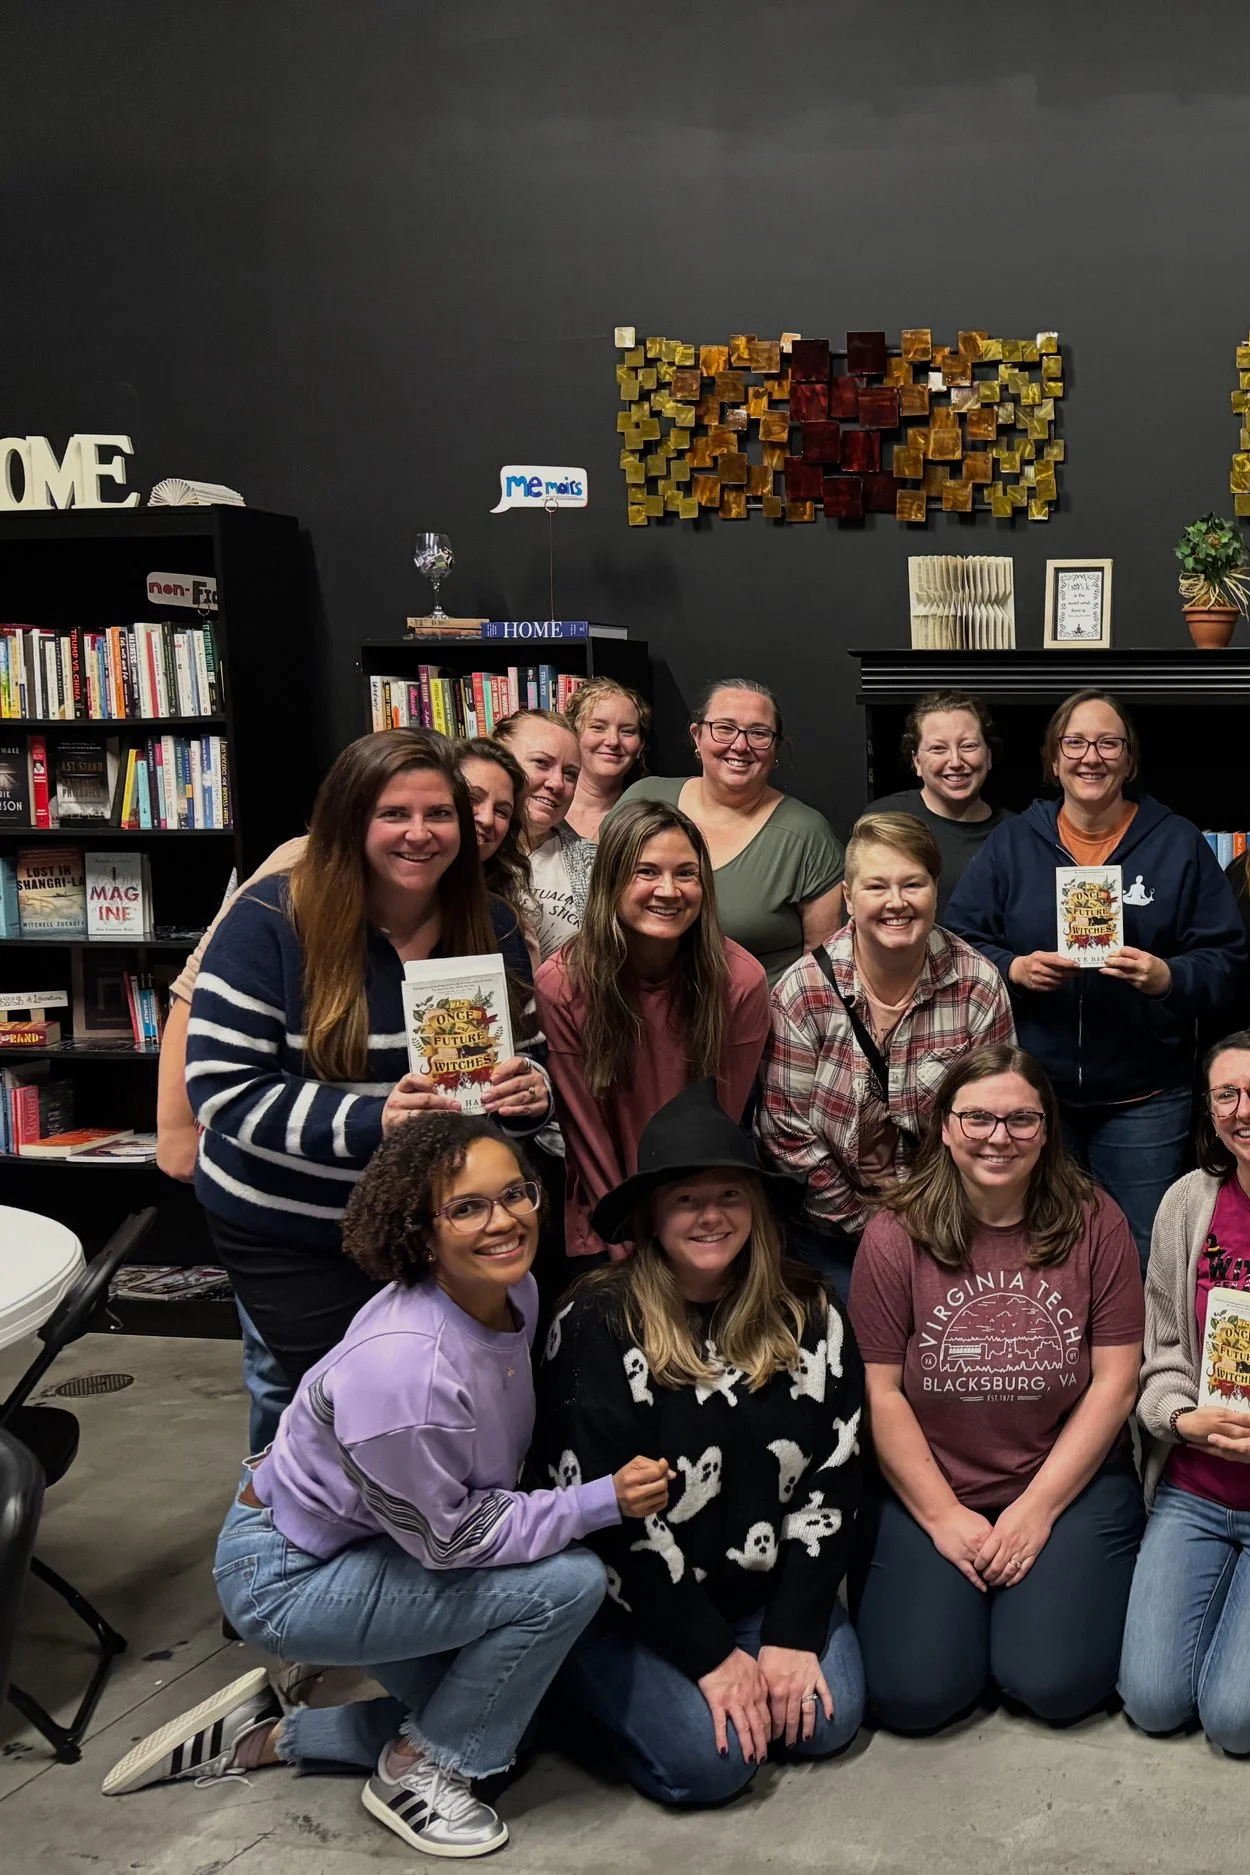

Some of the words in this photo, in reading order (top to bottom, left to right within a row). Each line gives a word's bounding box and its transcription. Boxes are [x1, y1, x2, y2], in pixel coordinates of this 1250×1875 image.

[504, 622, 562, 638] HOME
[71, 629, 79, 658] TRUMP
[203, 632, 212, 654] STARTS
[26, 866, 54, 878] LOST
[58, 866, 72, 876] IN
[90, 886, 140, 902] MAG
[1076, 891, 1101, 900] ONCE
[98, 906, 134, 922] INE
[1072, 926, 1111, 934] WITCHES
[437, 1010, 475, 1026] ONCE
[434, 1031, 485, 1046] FUTURE
[434, 1055, 492, 1072] WITCHES
[919, 1271, 1024, 1348] VIRGINIA
[1037, 1280, 1082, 1344] TECH
[923, 1377, 1051, 1392] BLACKSBURG,
[1059, 1373, 1076, 1388] VA
